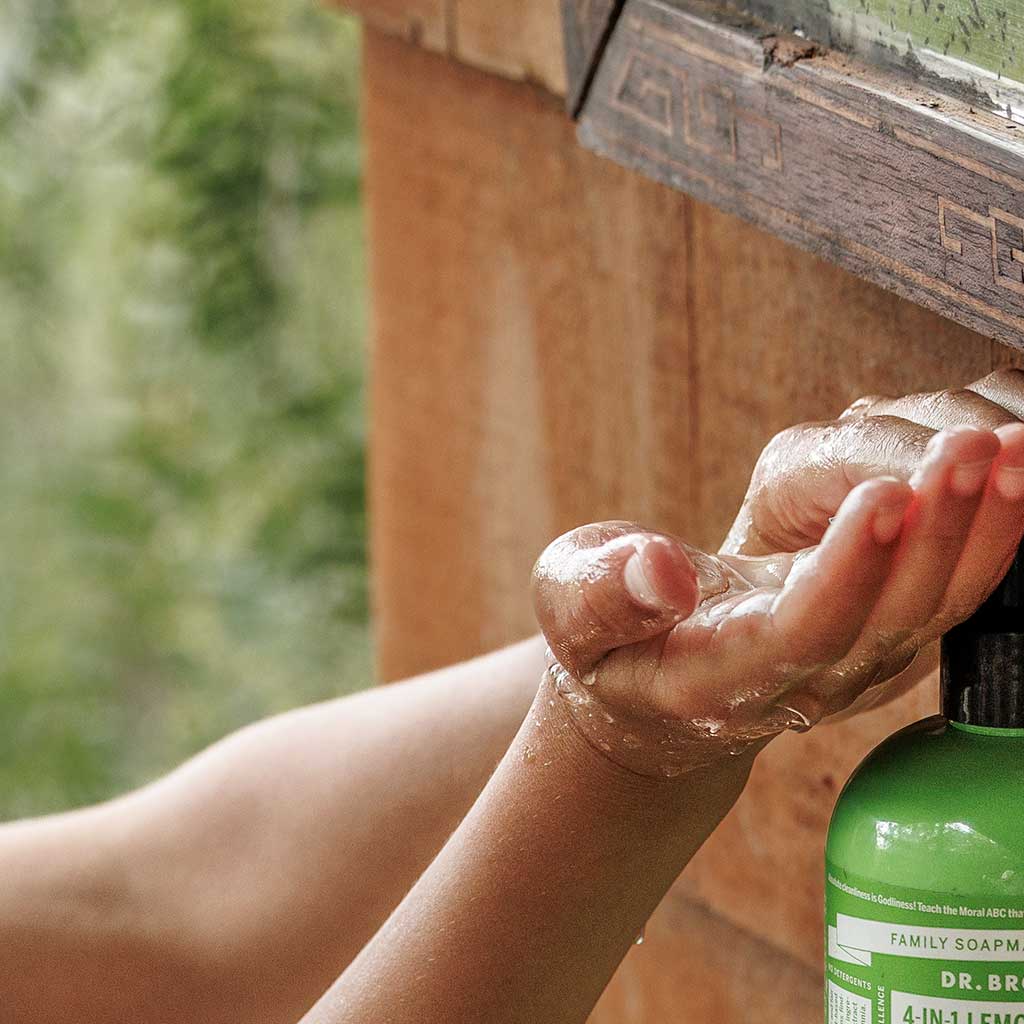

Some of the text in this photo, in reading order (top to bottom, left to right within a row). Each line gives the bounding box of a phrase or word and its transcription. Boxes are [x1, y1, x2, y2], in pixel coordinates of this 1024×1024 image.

[878, 895, 916, 910] Godliness!
[918, 902, 941, 914] Teach
[943, 905, 958, 916] the
[959, 906, 985, 918] Moral
[986, 908, 1006, 918] ABC
[891, 932, 948, 950] FAMILY
[834, 968, 872, 990] DETERGENTS
[941, 970, 982, 991] DR.
